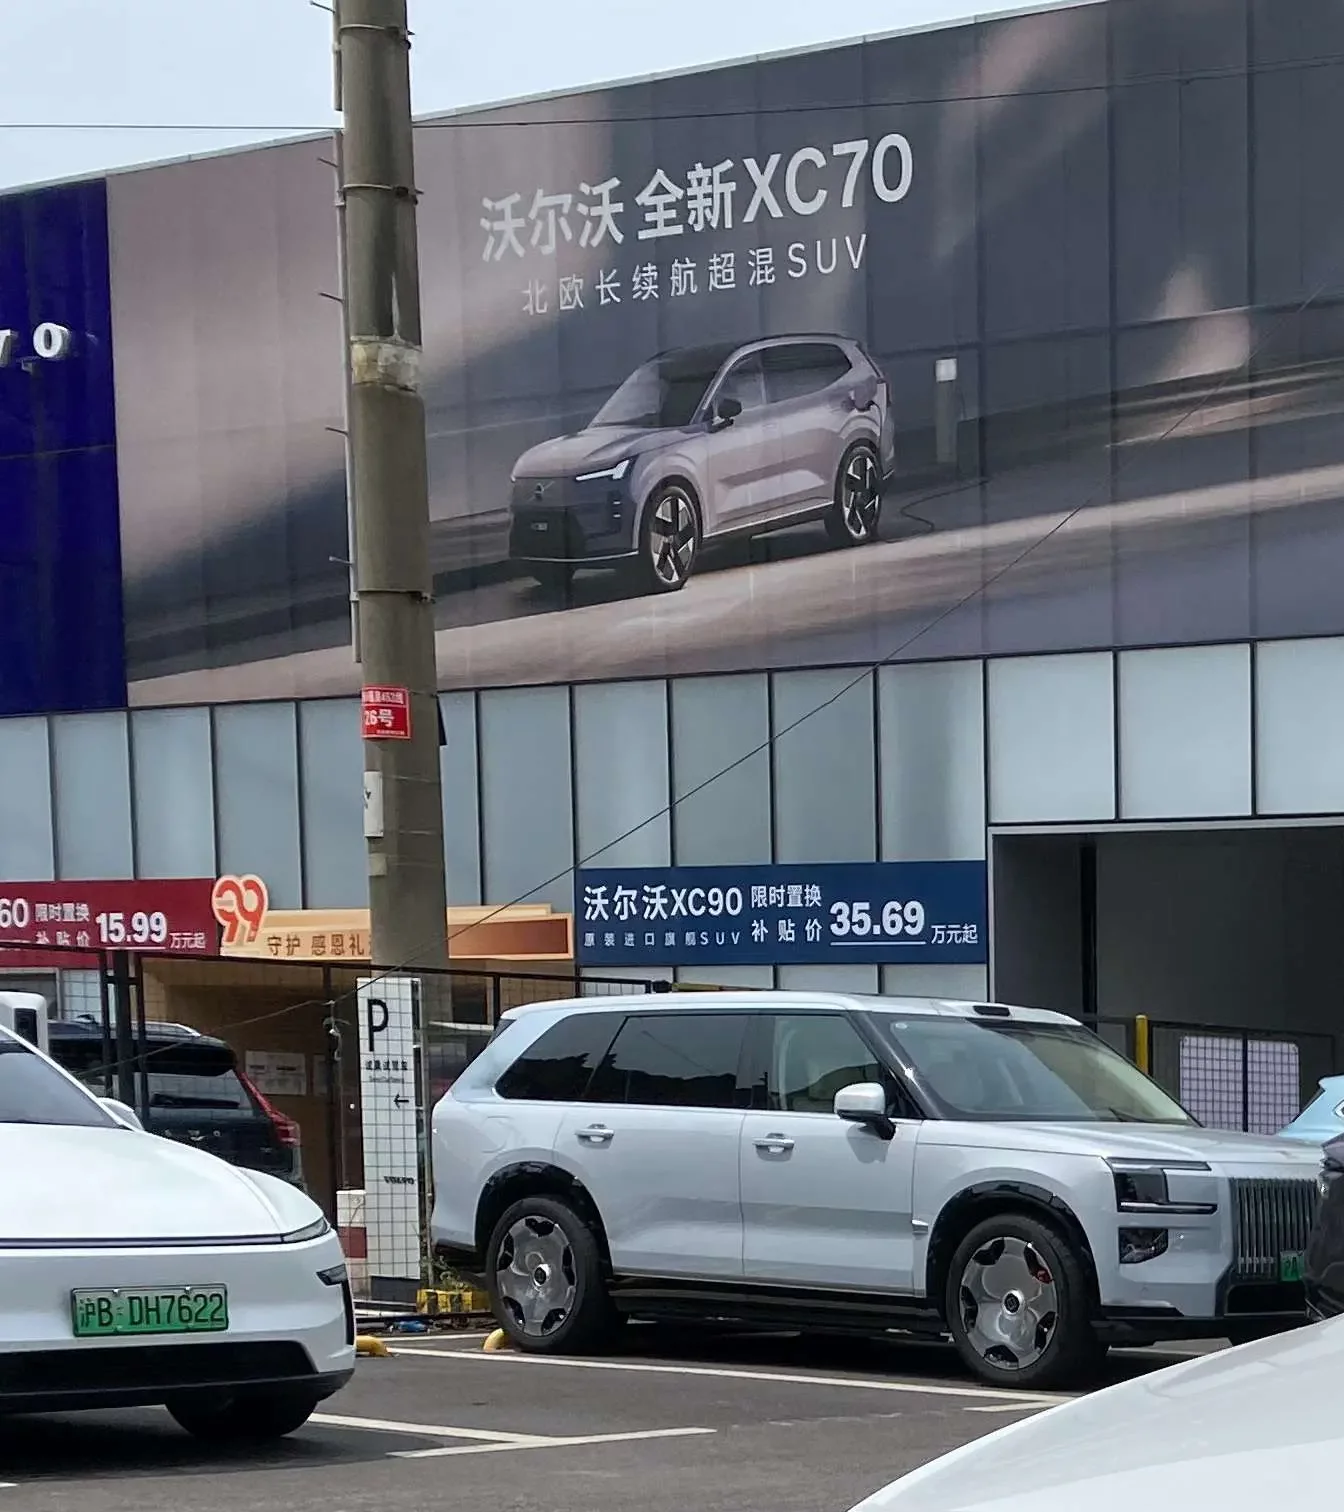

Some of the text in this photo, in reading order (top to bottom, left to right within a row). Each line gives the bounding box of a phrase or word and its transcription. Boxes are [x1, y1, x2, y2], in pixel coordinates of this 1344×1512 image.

[523, 234, 867, 316] 北欧长续航超混SUV
[583, 884, 743, 921] 沃尔沃XC90
[751, 884, 821, 908] 限时置换
[95, 911, 168, 943] 15.99
[751, 918, 822, 943] 补贴价
[829, 900, 925, 936] 35.69
[930, 923, 979, 945] 万元起
[311, 933, 372, 956] 感恩礼
[367, 998, 389, 1052] P
